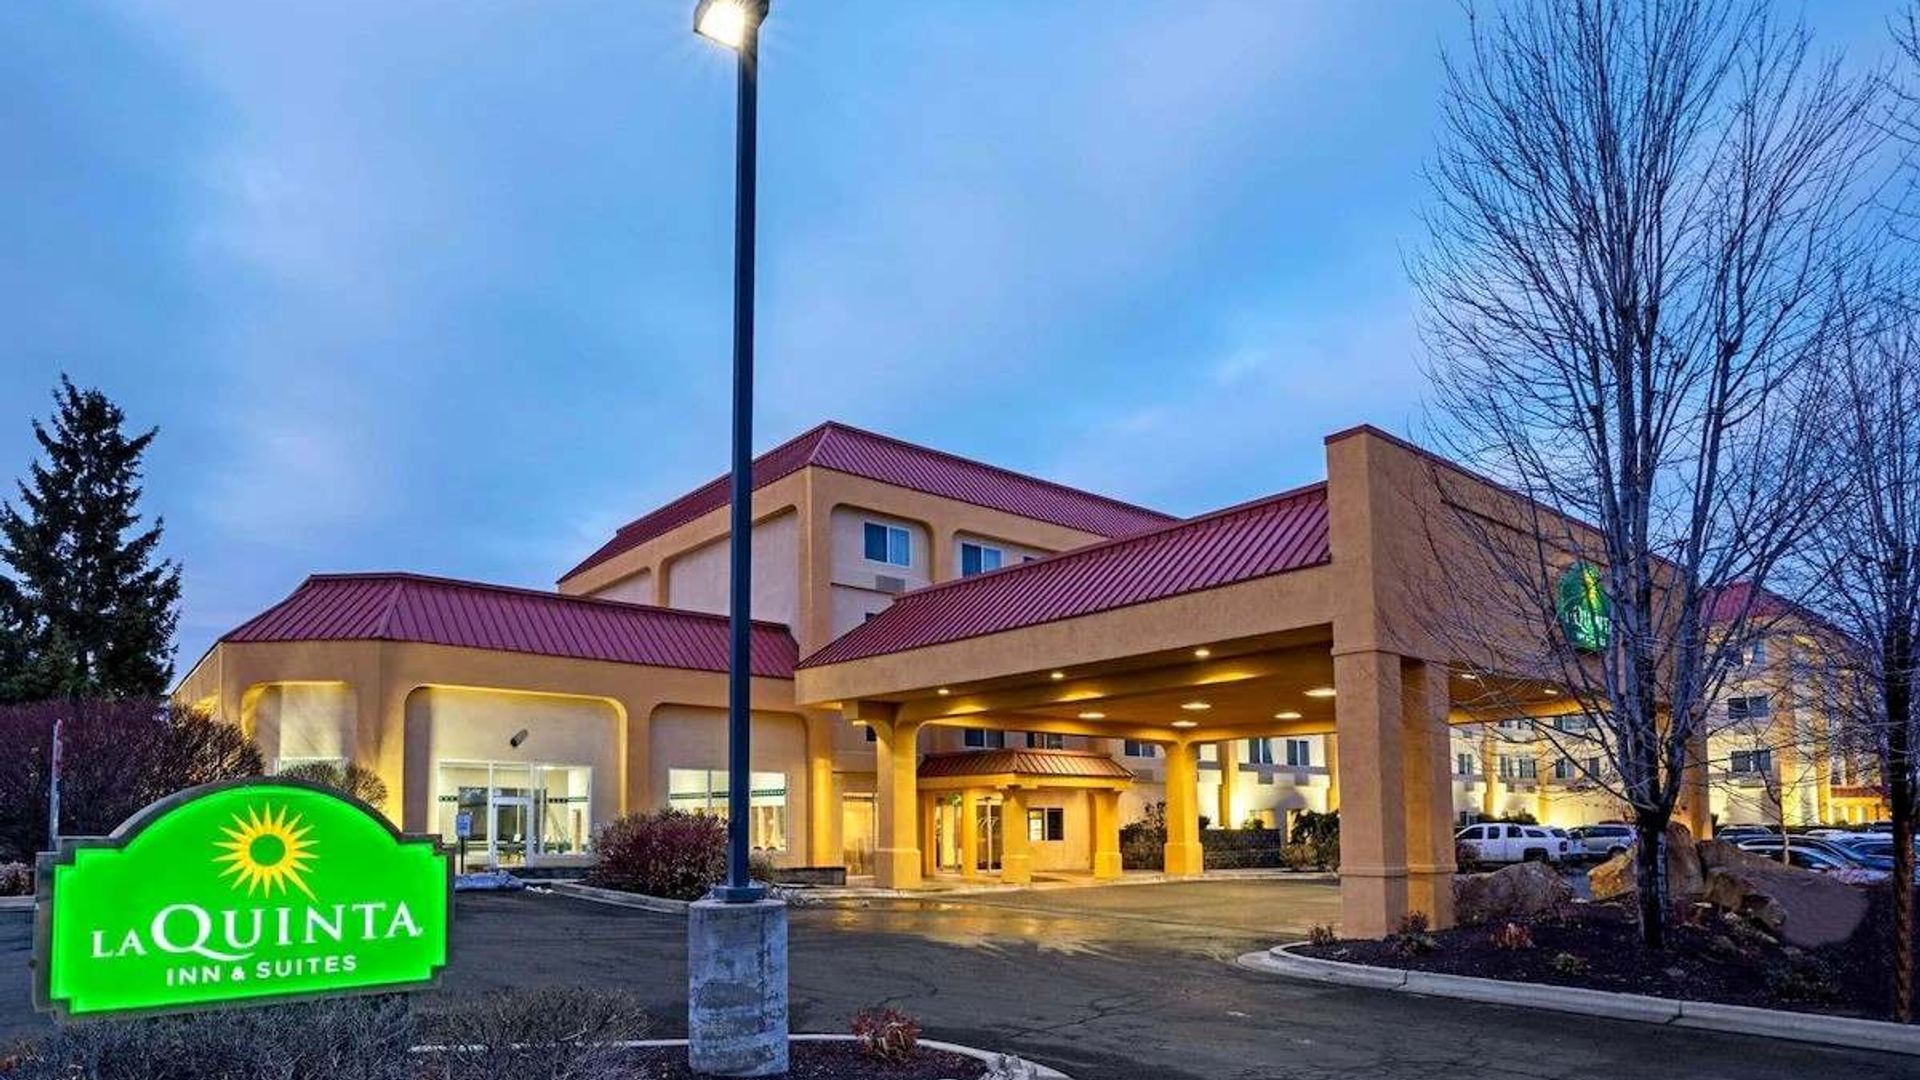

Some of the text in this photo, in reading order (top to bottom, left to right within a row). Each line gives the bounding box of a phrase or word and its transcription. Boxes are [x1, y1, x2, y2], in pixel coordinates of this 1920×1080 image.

[91, 902, 424, 961] LA QUINTA
[166, 954, 357, 986] INN & SUITES
